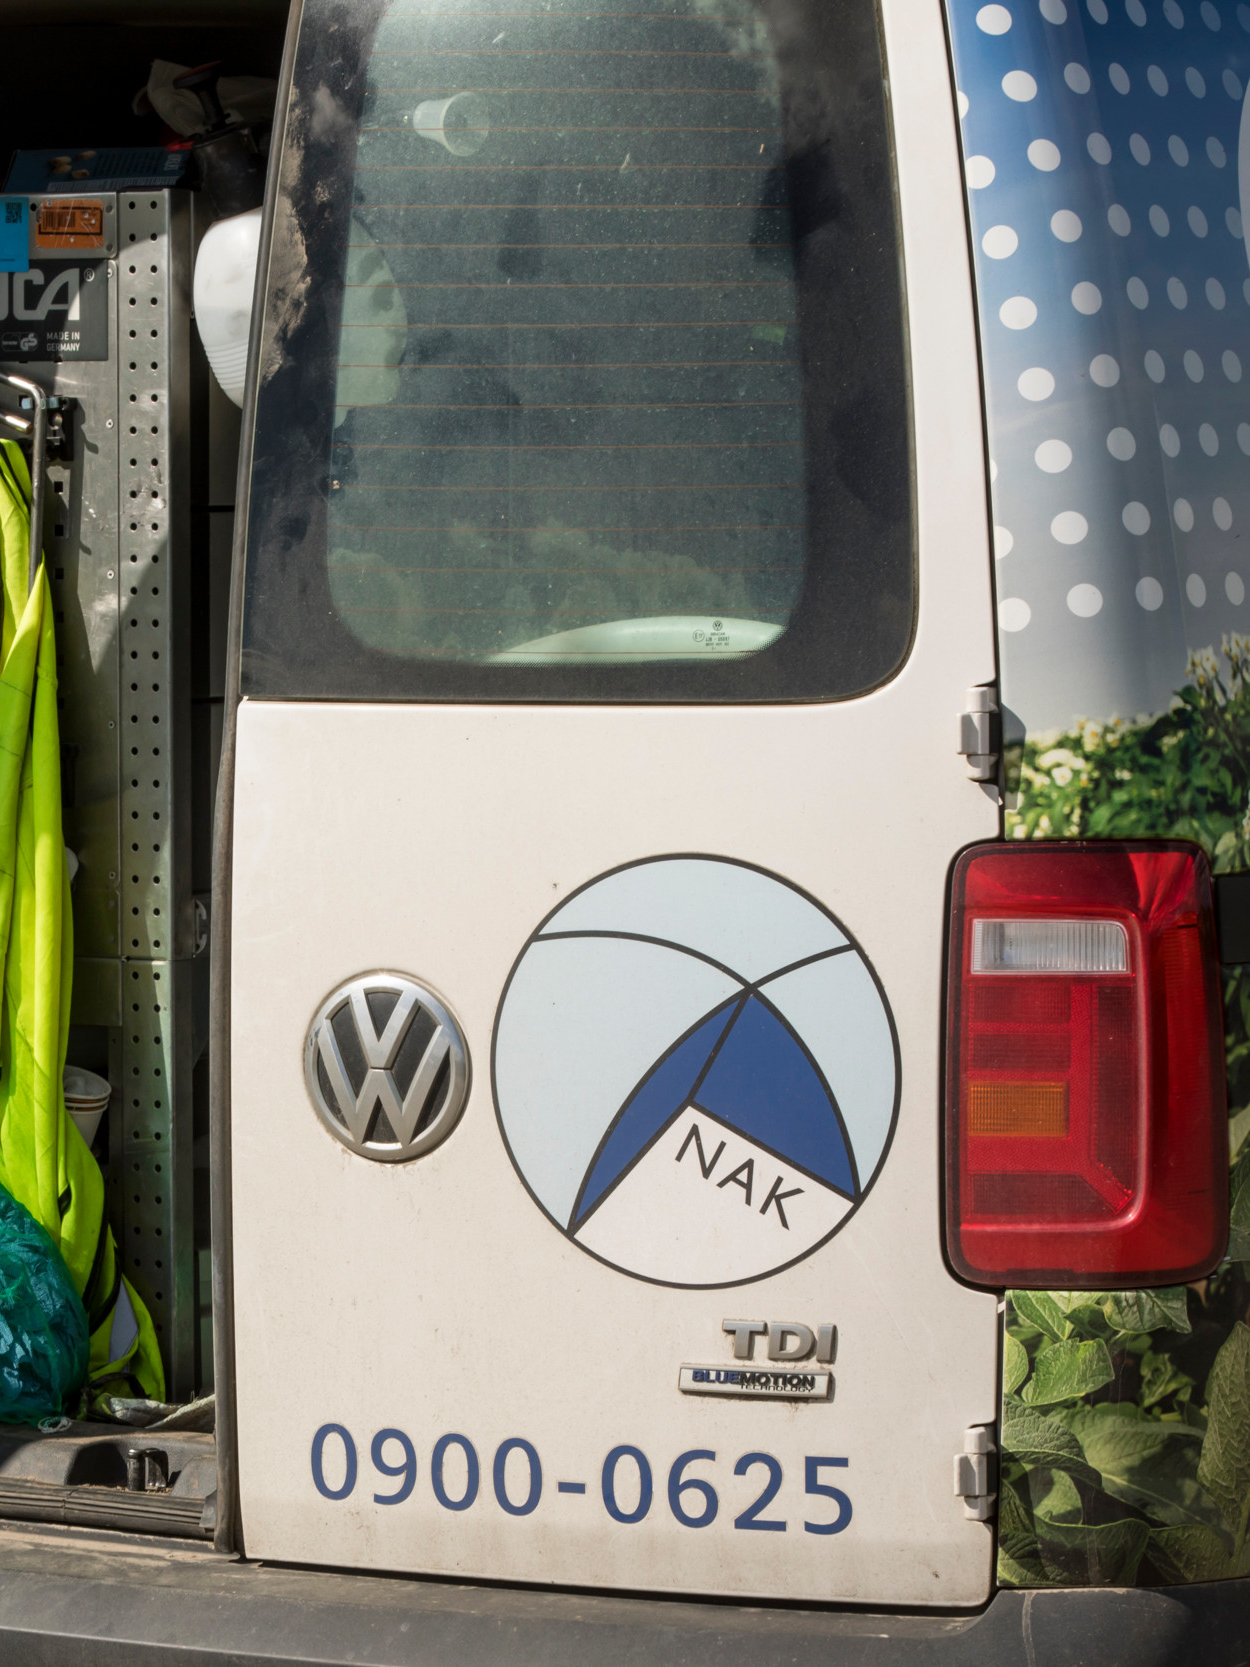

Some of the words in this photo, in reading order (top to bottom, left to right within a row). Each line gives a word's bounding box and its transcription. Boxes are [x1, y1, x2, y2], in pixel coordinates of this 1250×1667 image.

[46, 331, 69, 341] MADE
[71, 331, 80, 341] IN
[46, 342, 81, 352] GERMANY
[675, 1123, 805, 1231] NAK
[722, 1319, 838, 1364] TDI
[692, 1369, 816, 1388] BLUEMOTION
[739, 1383, 815, 1393] TECHNOLOGY
[310, 1422, 854, 1536] 0900-0625
